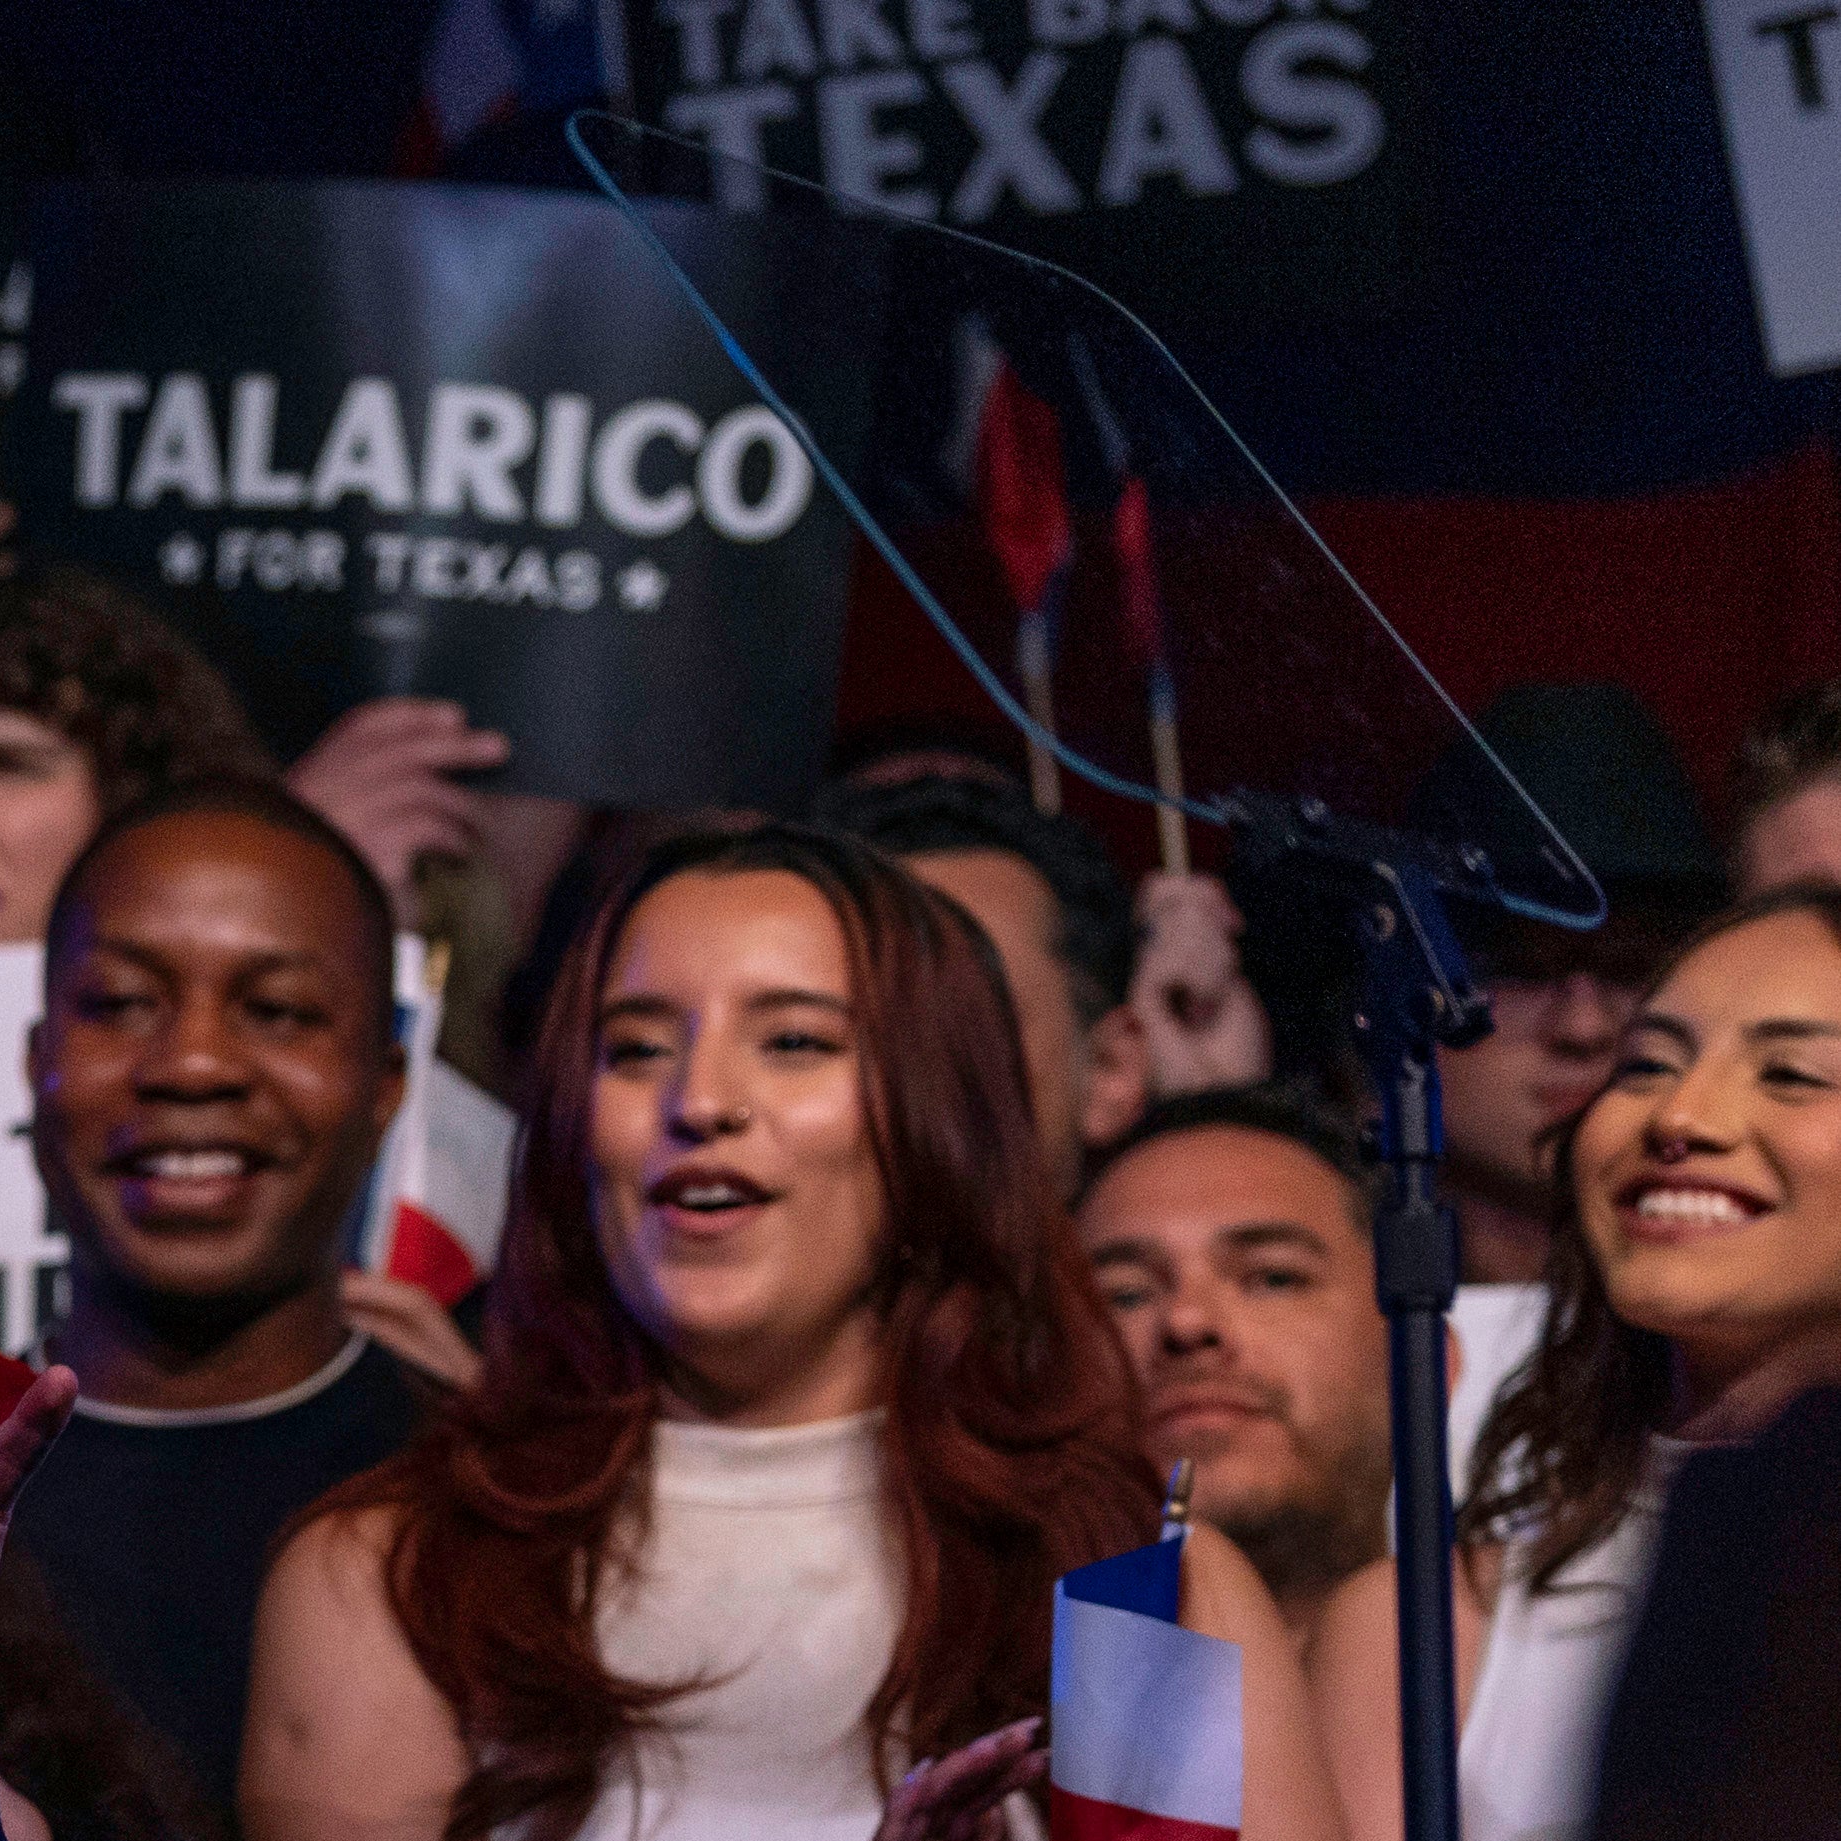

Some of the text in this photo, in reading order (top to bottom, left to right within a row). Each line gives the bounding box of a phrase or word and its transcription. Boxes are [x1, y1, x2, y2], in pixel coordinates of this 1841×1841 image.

[665, 18, 1386, 222] TEXAS
[49, 369, 815, 545] TALARICO
[214, 528, 602, 612] FOR TEXAS
